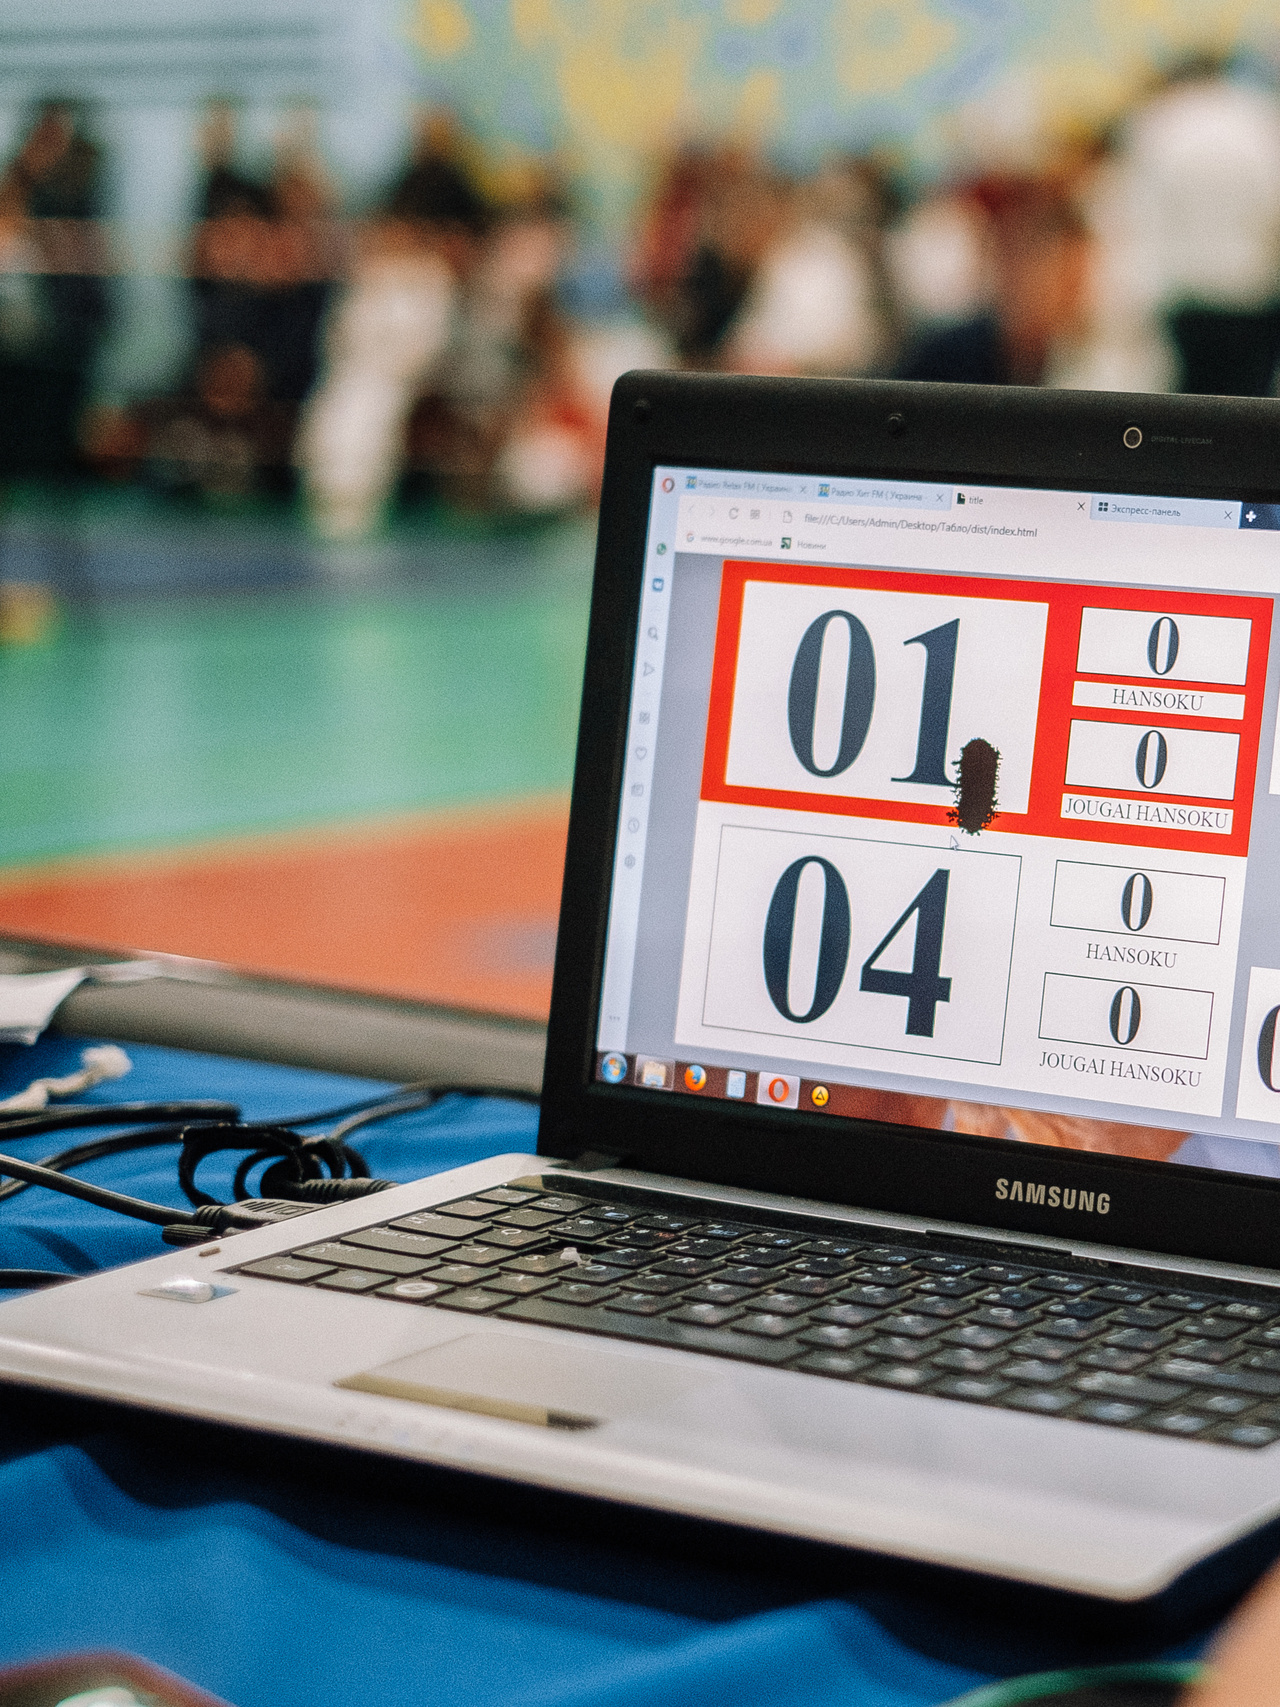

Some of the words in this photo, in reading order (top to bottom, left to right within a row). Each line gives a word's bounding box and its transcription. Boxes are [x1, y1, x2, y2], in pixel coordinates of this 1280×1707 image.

[969, 497, 984, 505] title
[1111, 503, 1181, 518] Экспресс-панель
[1147, 616, 1180, 675] 0
[787, 609, 962, 787] 01
[1112, 688, 1204, 711] HANSOKU
[1135, 730, 1168, 789] 0
[1065, 798, 1132, 820] JOUGAI
[1136, 805, 1229, 829] HANSOKU
[1121, 872, 1153, 932] 0
[762, 855, 953, 1038] 04
[1086, 943, 1178, 968] HANSOKU
[1109, 986, 1142, 1045] 0
[1039, 1051, 1106, 1075] JOUGAI
[1110, 1060, 1202, 1088] HANSOKU
[995, 1178, 1111, 1214] SAMSUNG
